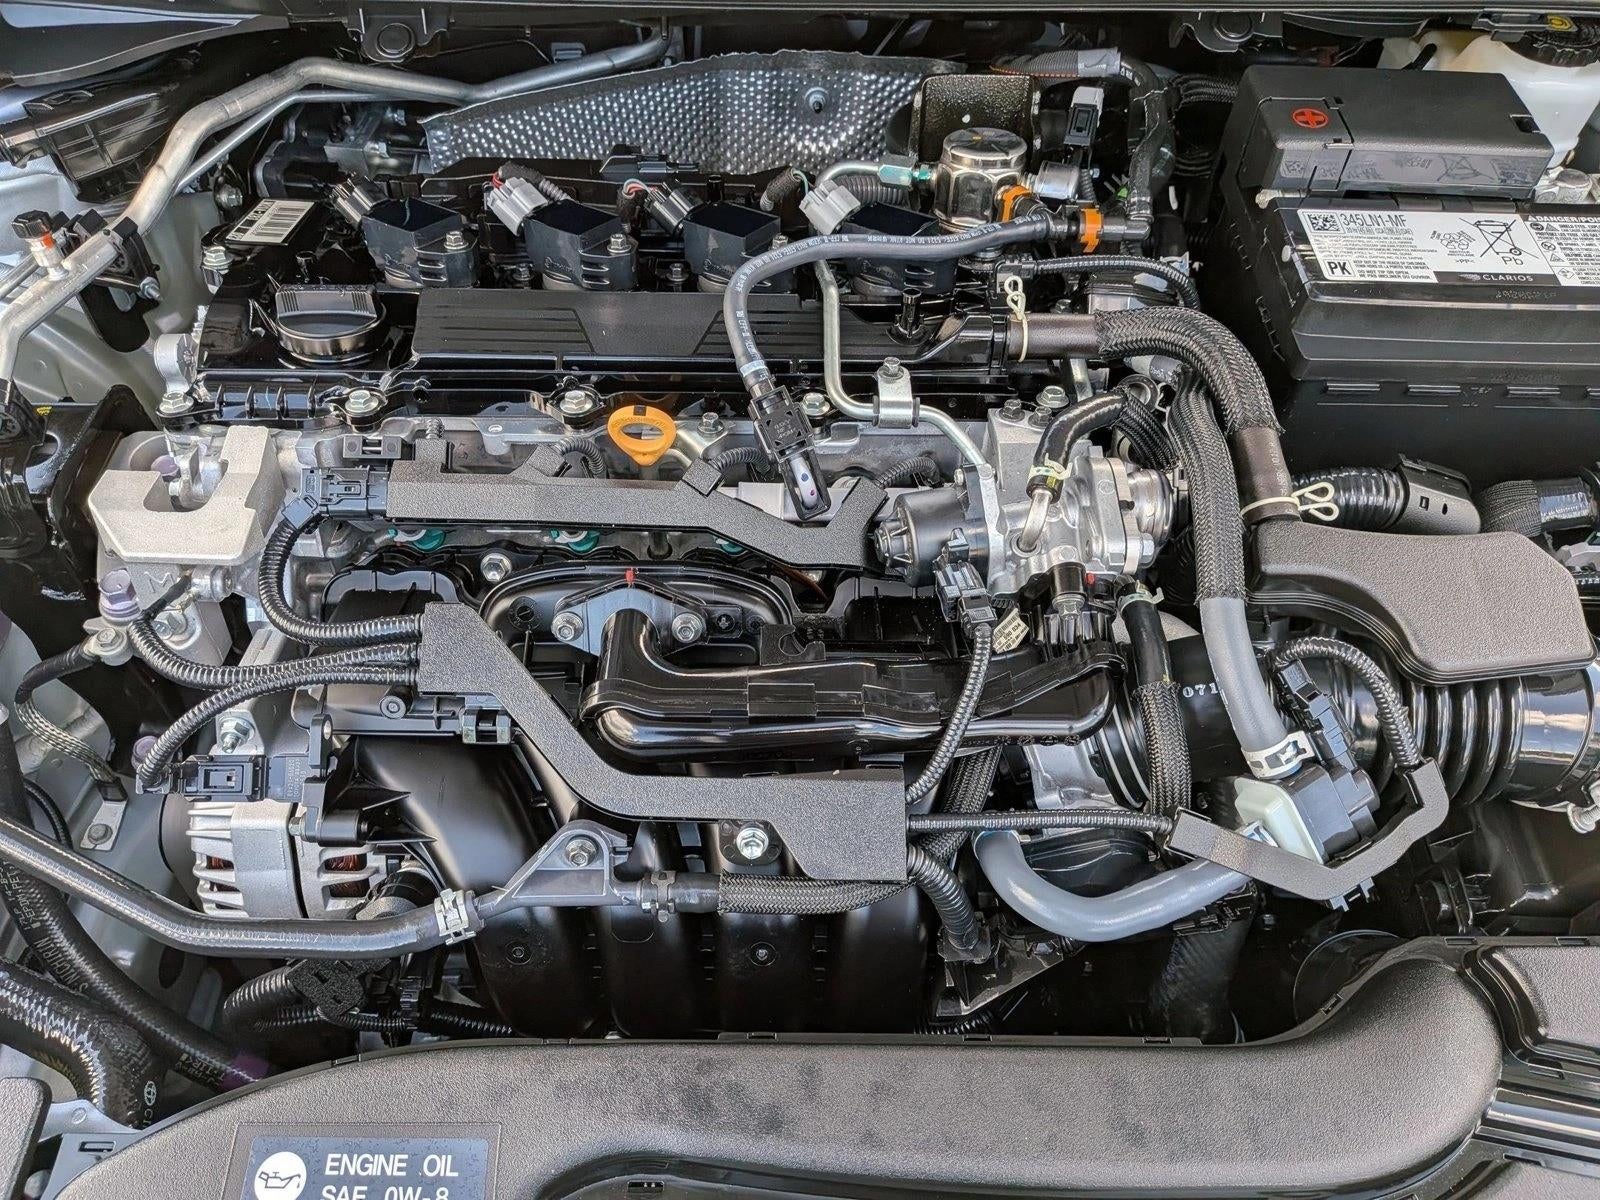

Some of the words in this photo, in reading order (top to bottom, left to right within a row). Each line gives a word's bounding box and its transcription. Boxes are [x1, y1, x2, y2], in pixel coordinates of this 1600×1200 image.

[1340, 213, 1407, 228] 345LN1-MF
[1327, 261, 1352, 276] PK
[1502, 256, 1524, 266] Pb
[1482, 274, 1534, 282] CLARIOS
[1182, 682, 1219, 698] 071
[33, 936, 81, 985] NICHIRIN
[324, 1153, 409, 1177] ENGINE
[422, 1154, 459, 1177] OIL
[319, 1185, 368, 1200] SAE
[384, 1186, 449, 1200] 0W-8
